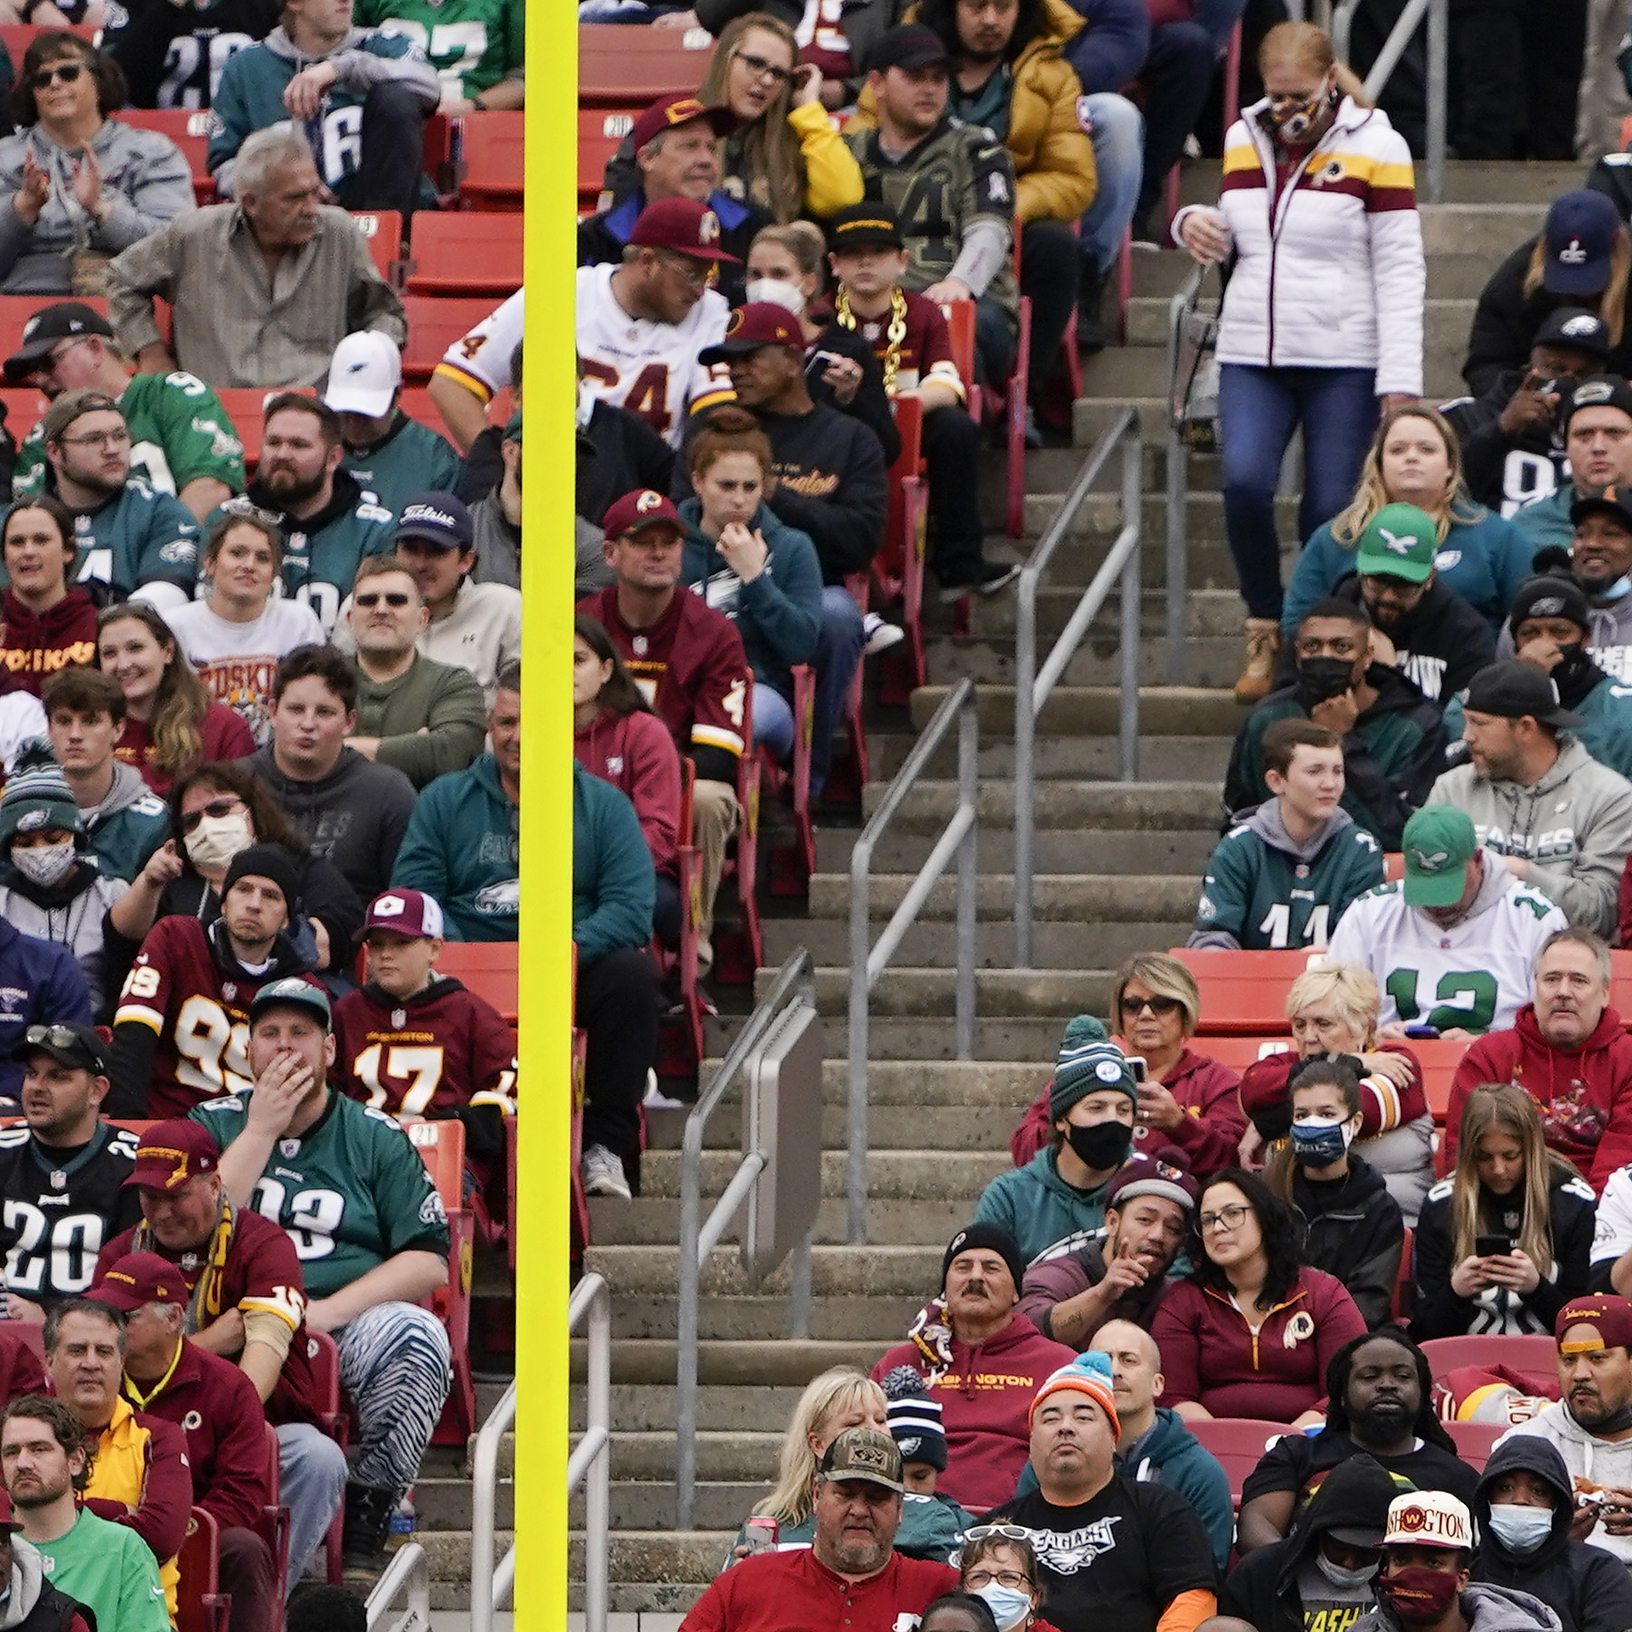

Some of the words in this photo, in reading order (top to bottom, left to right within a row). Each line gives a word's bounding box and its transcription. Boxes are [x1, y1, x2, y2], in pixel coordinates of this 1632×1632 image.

[401, 504, 457, 530] Titleist
[1260, 904, 1329, 948] 11
[1385, 968, 1497, 1032] 12
[352, 1046, 446, 1122] 17
[4, 1199, 86, 1292] 20
[1032, 1515, 1119, 1552] EAGLES
